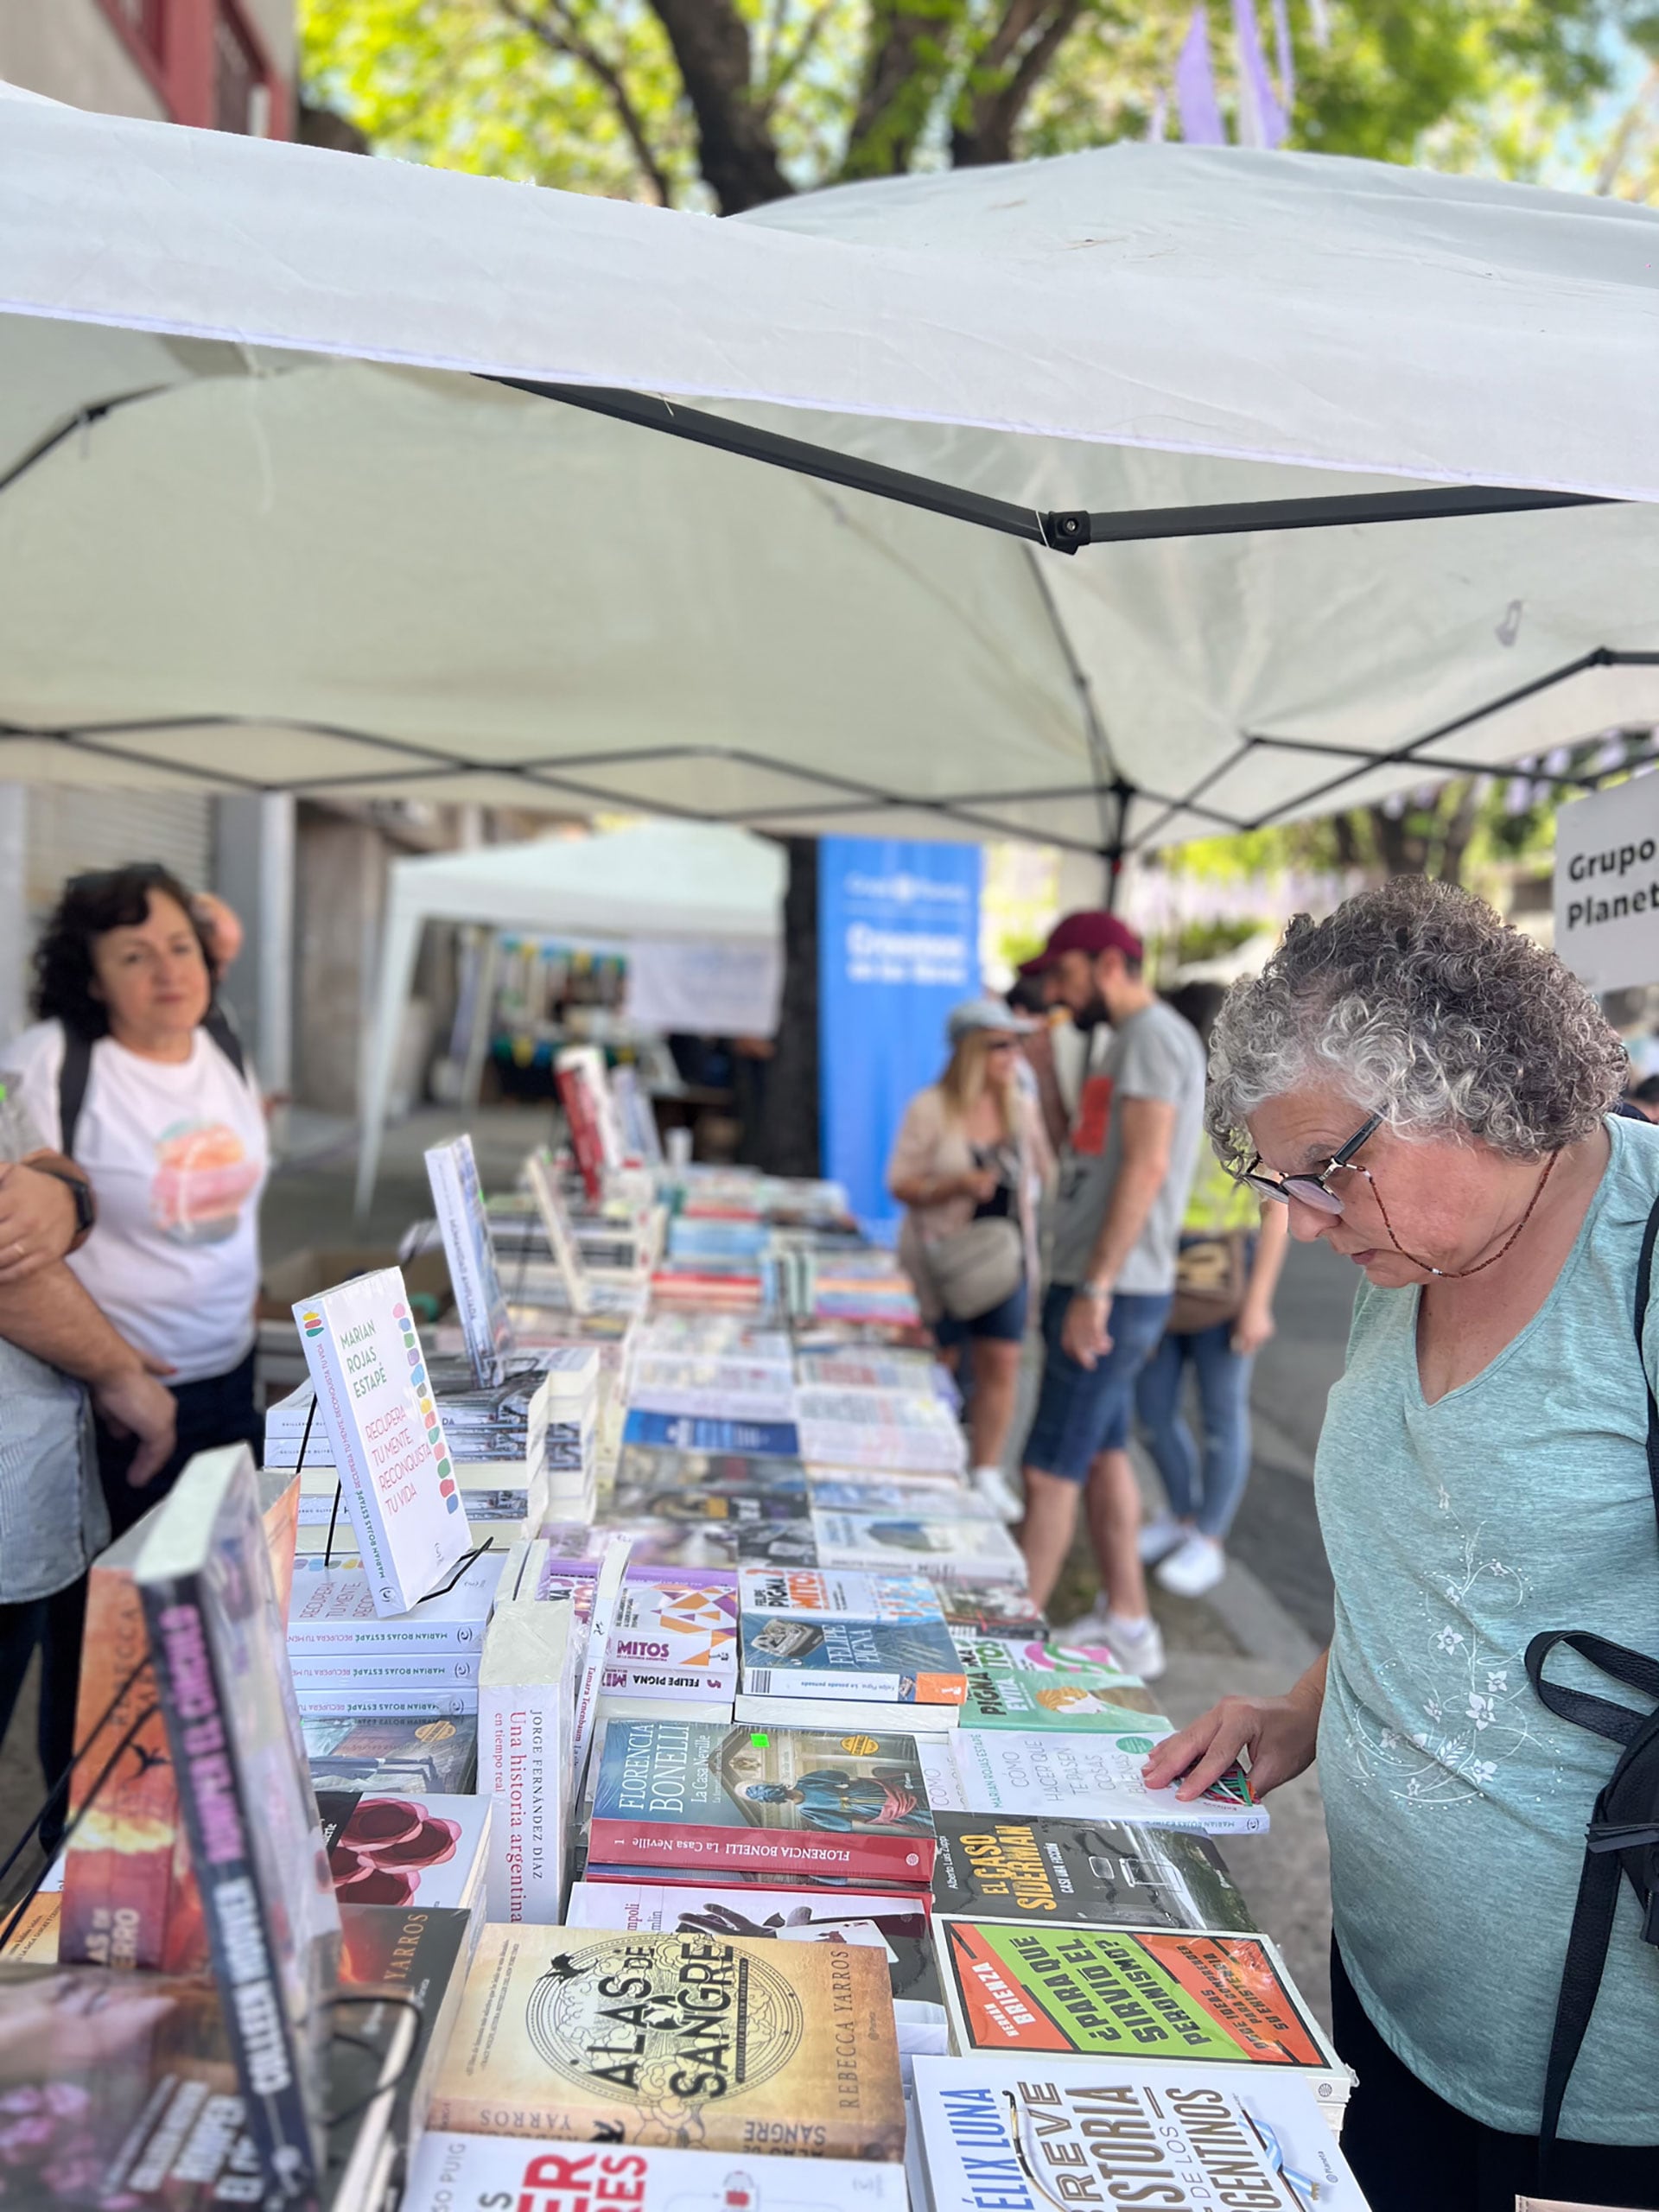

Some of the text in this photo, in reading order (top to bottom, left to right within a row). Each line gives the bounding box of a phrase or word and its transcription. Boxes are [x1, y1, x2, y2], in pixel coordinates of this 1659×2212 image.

[1568, 839, 1656, 882] Grupo
[315, 1343, 327, 1360] VIDA
[340, 1319, 376, 1350] MARIAN
[320, 1359, 329, 1370] TU
[346, 1346, 377, 1374] ROJAS
[324, 1370, 343, 1419] RECONQUISTA
[353, 1363, 387, 1398] ESTAPÉ
[365, 1405, 406, 1441] RECUPERA
[342, 1443, 353, 1454] TU
[372, 1446, 385, 1466] TU
[378, 1442, 431, 1491] RECONQUISTA
[346, 1453, 362, 1489] RECUPERA
[354, 1489, 370, 1521] ESTAPÉ
[385, 1482, 417, 1516] TU VIDA
[364, 1520, 377, 1547] ROJAS
[372, 1547, 385, 1579] MARIAN
[300, 1581, 337, 1618] RECUPERA
[766, 1577, 789, 1608] PIGNA
[355, 1634, 385, 1643] ESTAPÉ
[617, 1640, 670, 1657] MITOS
[822, 1624, 855, 1664] FELIPE
[849, 1629, 880, 1663] PIGNA
[971, 1640, 1012, 1669] ITOS
[582, 1666, 596, 1695] Tamara
[632, 1675, 666, 1686] PIGNA
[669, 1675, 700, 1688] FELIPE
[967, 1672, 1007, 1715] PIGNA
[995, 1675, 1029, 1711] EVITA
[574, 1696, 591, 1742] Tenenbaum
[493, 1713, 505, 1793] en tiempo real
[619, 1724, 654, 1810] FLORENCIA
[649, 1725, 690, 1813] BONELLI
[691, 1734, 711, 1803] La Casa Neville
[977, 1757, 995, 1780] ROJAS
[1025, 1740, 1048, 1763] QUE
[1035, 1764, 1064, 1802] HACER
[1058, 1747, 1089, 1796] TE PASEN
[1085, 1755, 1116, 1790] COSAS
[530, 1710, 543, 1879] JORGE FERNÁNDEZ DÍAZ
[984, 1779, 1003, 1808] MARIAN
[506, 1710, 528, 1923] Una historia argentina
[632, 1838, 851, 1861] FLORENCIA BONELLI La Casa Neville
[938, 1835, 959, 1890] Alberto Luis Zuppi
[959, 1834, 1013, 1879] CASO
[995, 1825, 1058, 1911] SIDERMAN
[1044, 1842, 1075, 1894] CASI UNA FICCIÓN
[981, 1881, 1010, 1895] EL
[383, 1913, 429, 1981] YARROS
[971, 1961, 1037, 2025] BRIENZA
[1008, 1936, 1122, 2042] ¿PARA QUÉ
[1056, 1938, 1169, 2044] SIRVIÓ EL
[1094, 1939, 1212, 2046] PERONISMO?
[1176, 1944, 1263, 2024] PARA COMPRENDER
[587, 1946, 655, 2091] ALAS DE
[670, 1943, 734, 2099] SANGRE
[1201, 1989, 1239, 2020] IDEAS
[830, 1950, 861, 2109] REBECCA YARROS
[1265, 2016, 1289, 2031] SU
[480, 2109, 572, 2131] YARROS
[744, 2121, 826, 2146] SANGRE
[440, 2142, 467, 2183] PUIG
[939, 2088, 1035, 2210] ÉLIX LUNA
[1017, 2082, 1105, 2212] REVE
[1159, 2126, 1211, 2199] DE LOS
[1166, 2088, 1283, 2212] GENTINOS
[1318, 2151, 1333, 2173] Planeta
